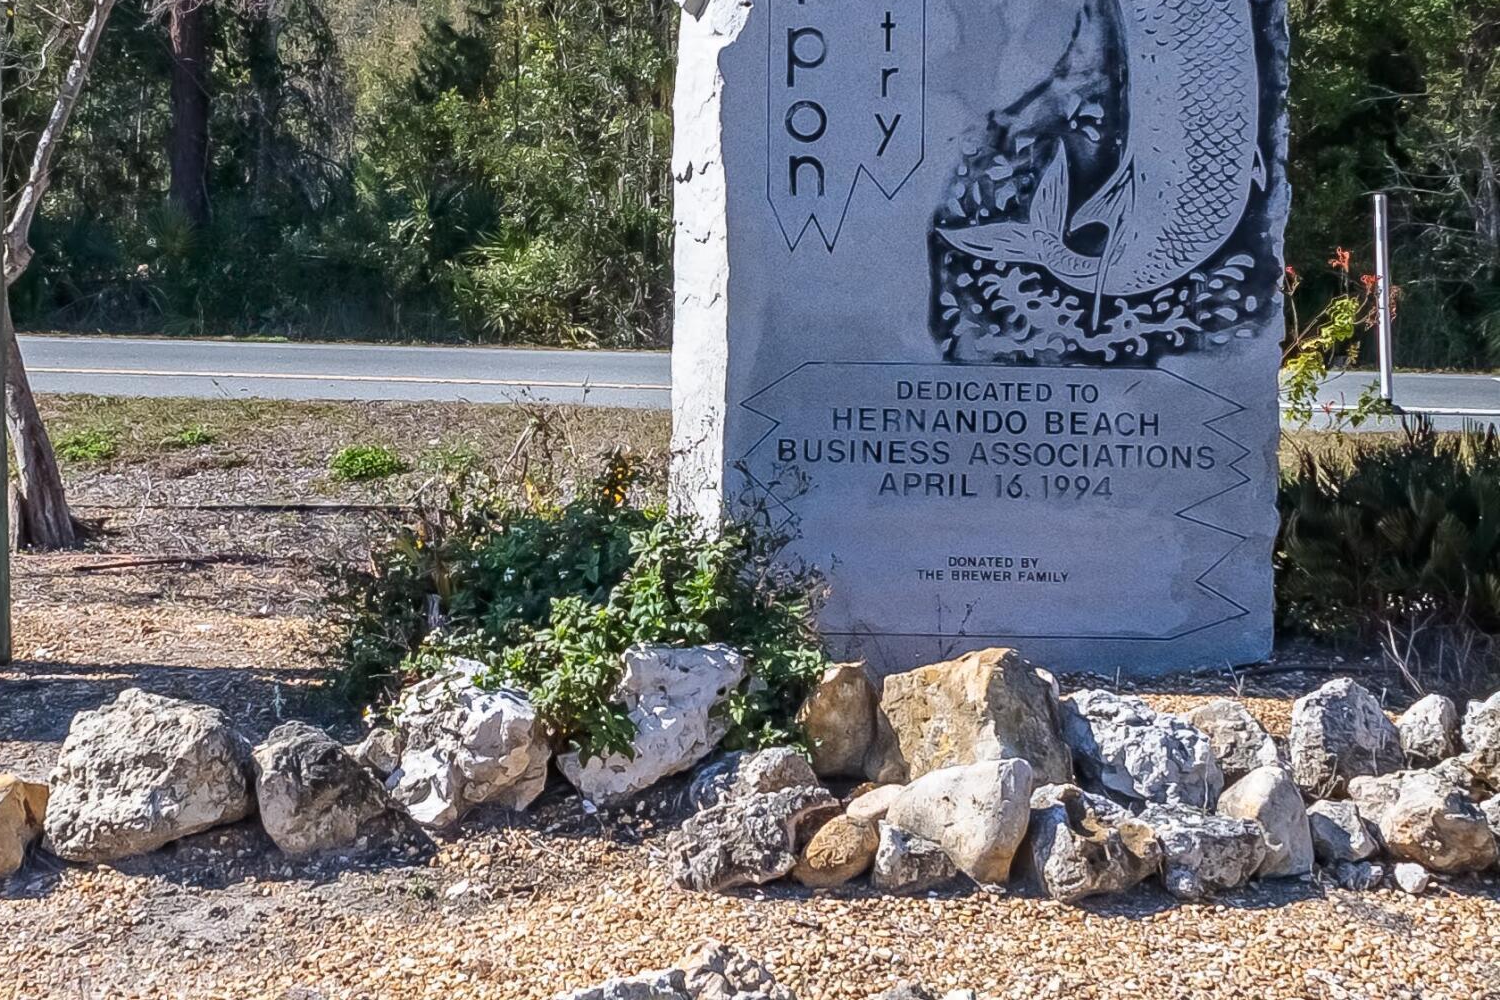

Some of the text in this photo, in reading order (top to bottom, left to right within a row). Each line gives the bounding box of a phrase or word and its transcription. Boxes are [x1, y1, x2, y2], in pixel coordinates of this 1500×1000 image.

[896, 380, 1099, 403] DEDICATED TO
[832, 408, 1160, 437] HERNANDO BEACH
[777, 438, 1216, 470] BUSINESS ASSOCIATIONS
[879, 472, 977, 498] APRIL
[947, 556, 1039, 569] DONATED BY
[916, 569, 1069, 583] THE BREWER FAMILY
